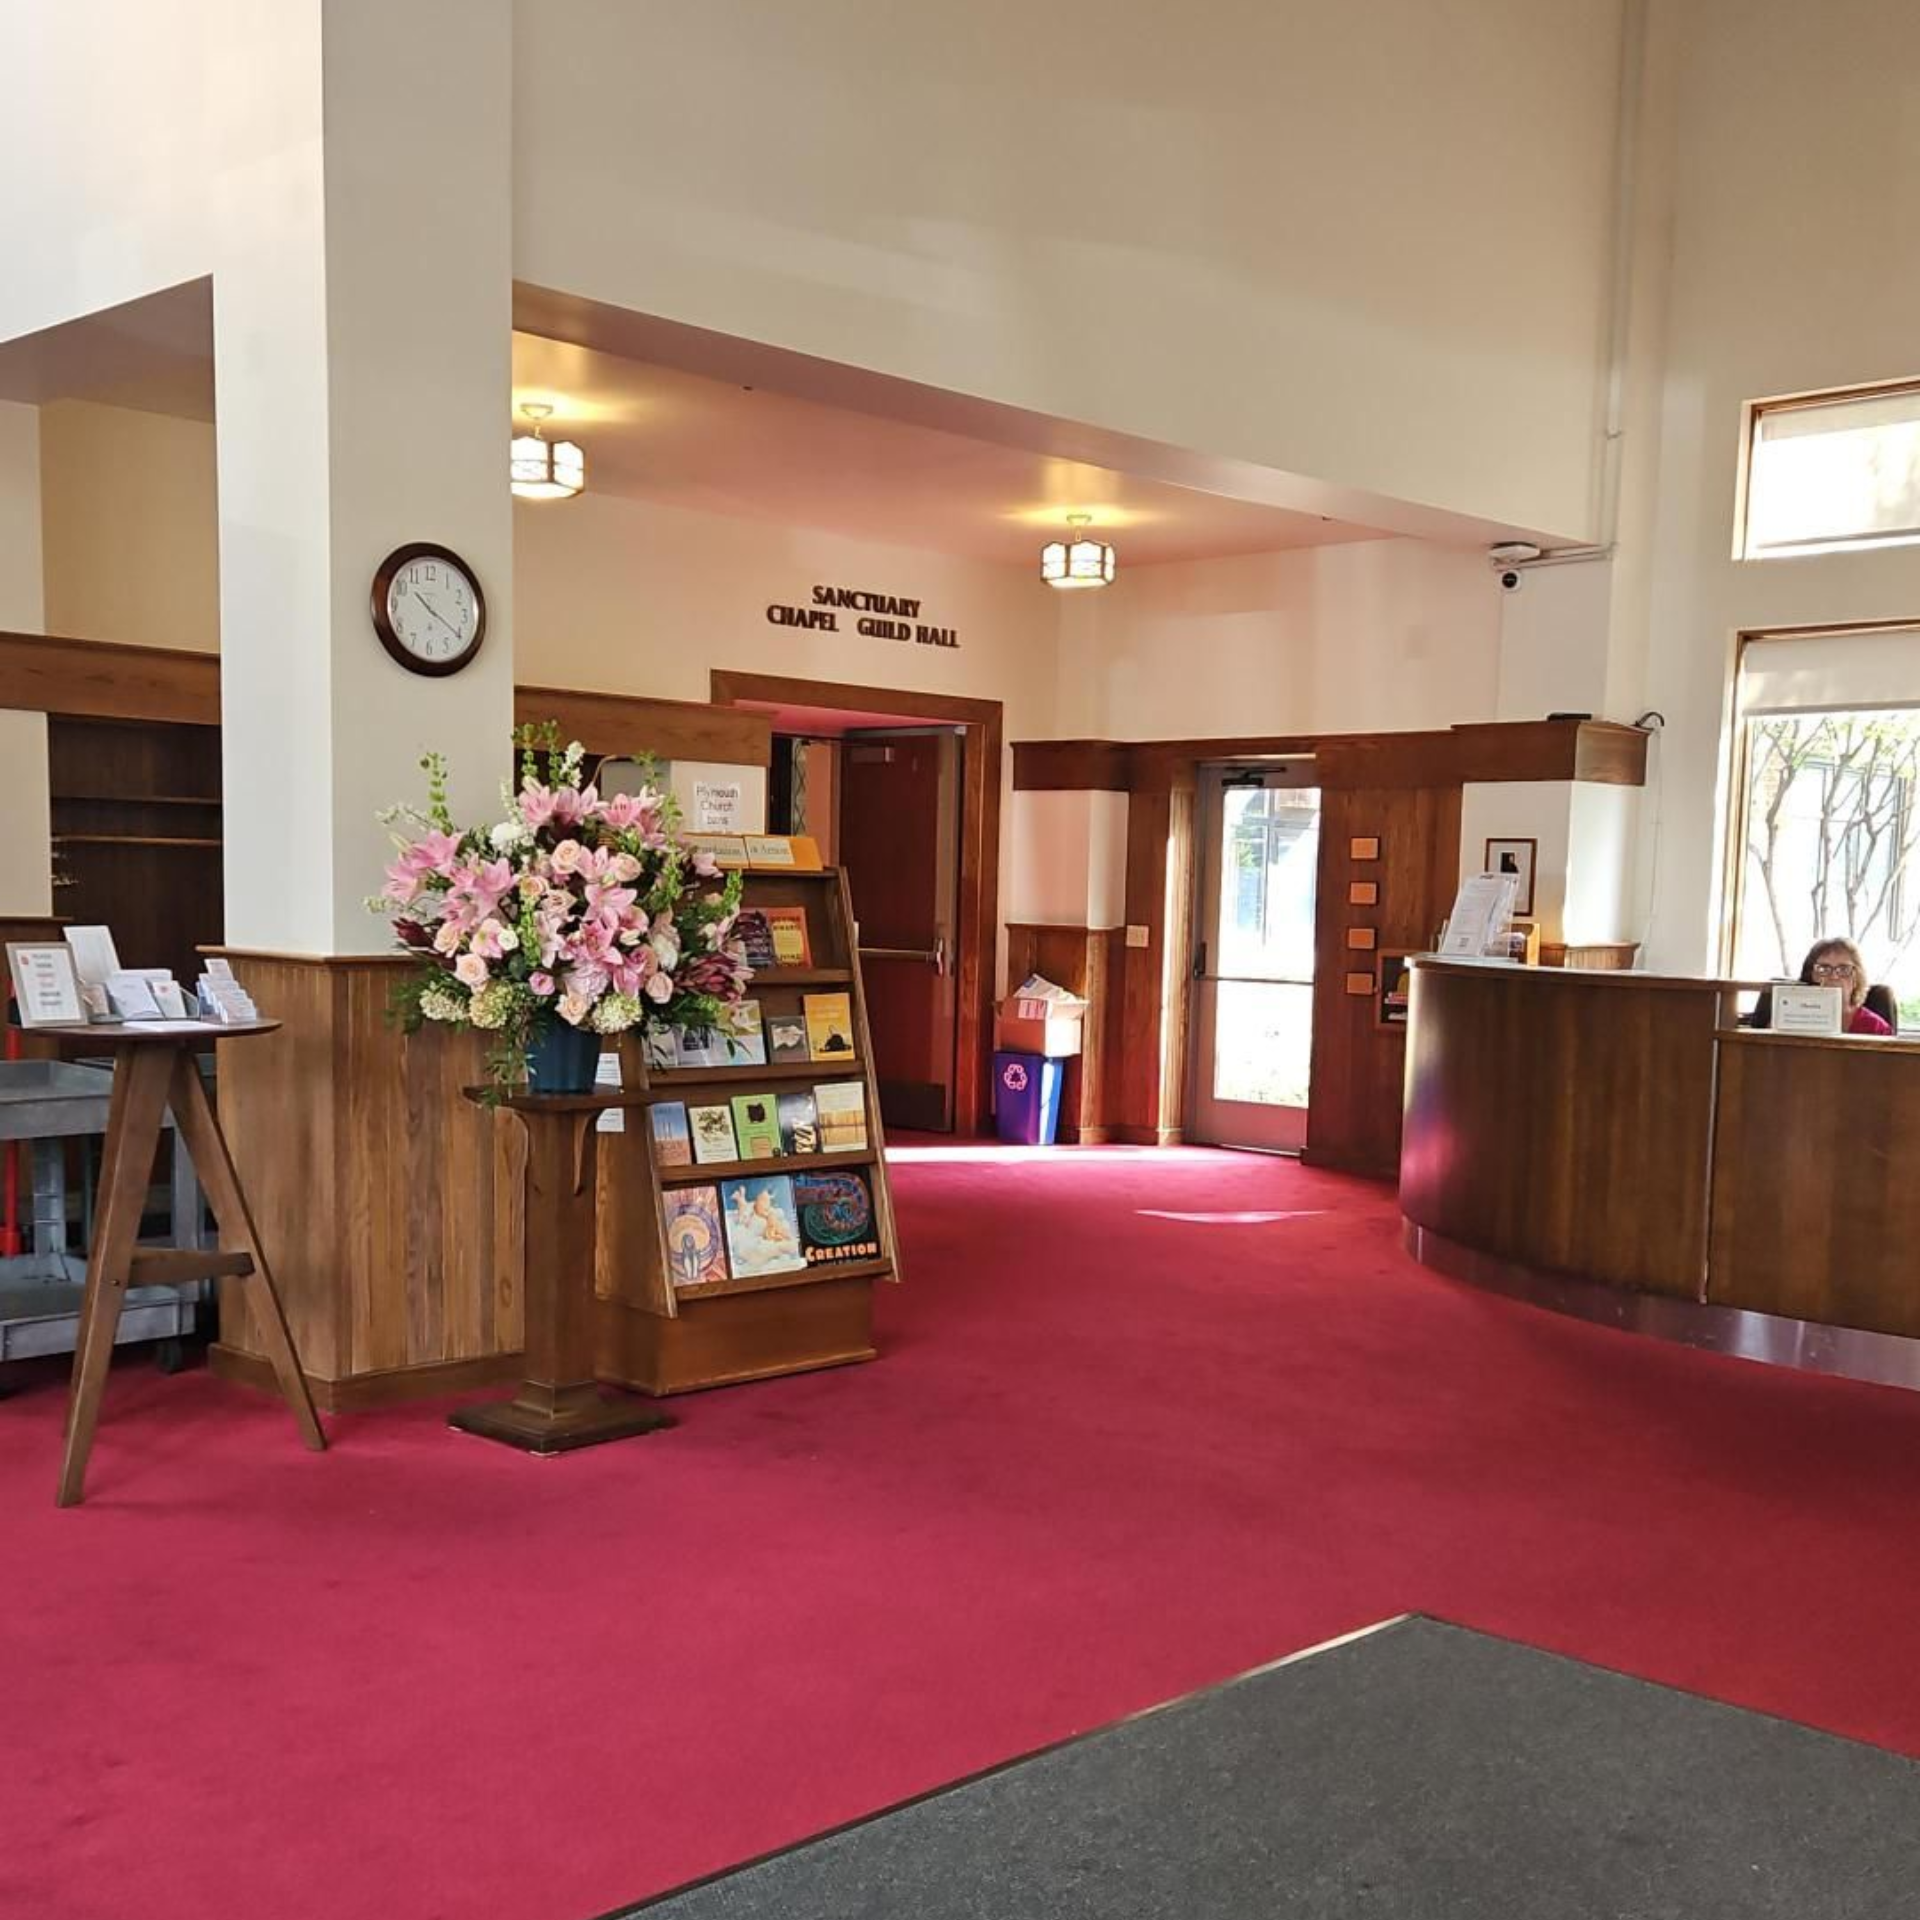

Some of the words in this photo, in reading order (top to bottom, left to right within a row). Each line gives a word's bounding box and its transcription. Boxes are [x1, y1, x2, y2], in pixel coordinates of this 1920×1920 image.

[409, 567, 419, 584] 11
[425, 565, 436, 581] 12
[455, 589, 461, 605] 2
[812, 585, 921, 618] SANCTUARY
[461, 608, 468, 624] 3
[766, 604, 839, 632] CHAPEL
[856, 617, 911, 641] GUILD
[915, 625, 960, 648] HALL
[410, 631, 416, 648] 7
[426, 639, 433, 655] 6
[696, 785, 739, 799] Plymouth
[700, 800, 734, 812] Church
[805, 1241, 877, 1262] CREATION
